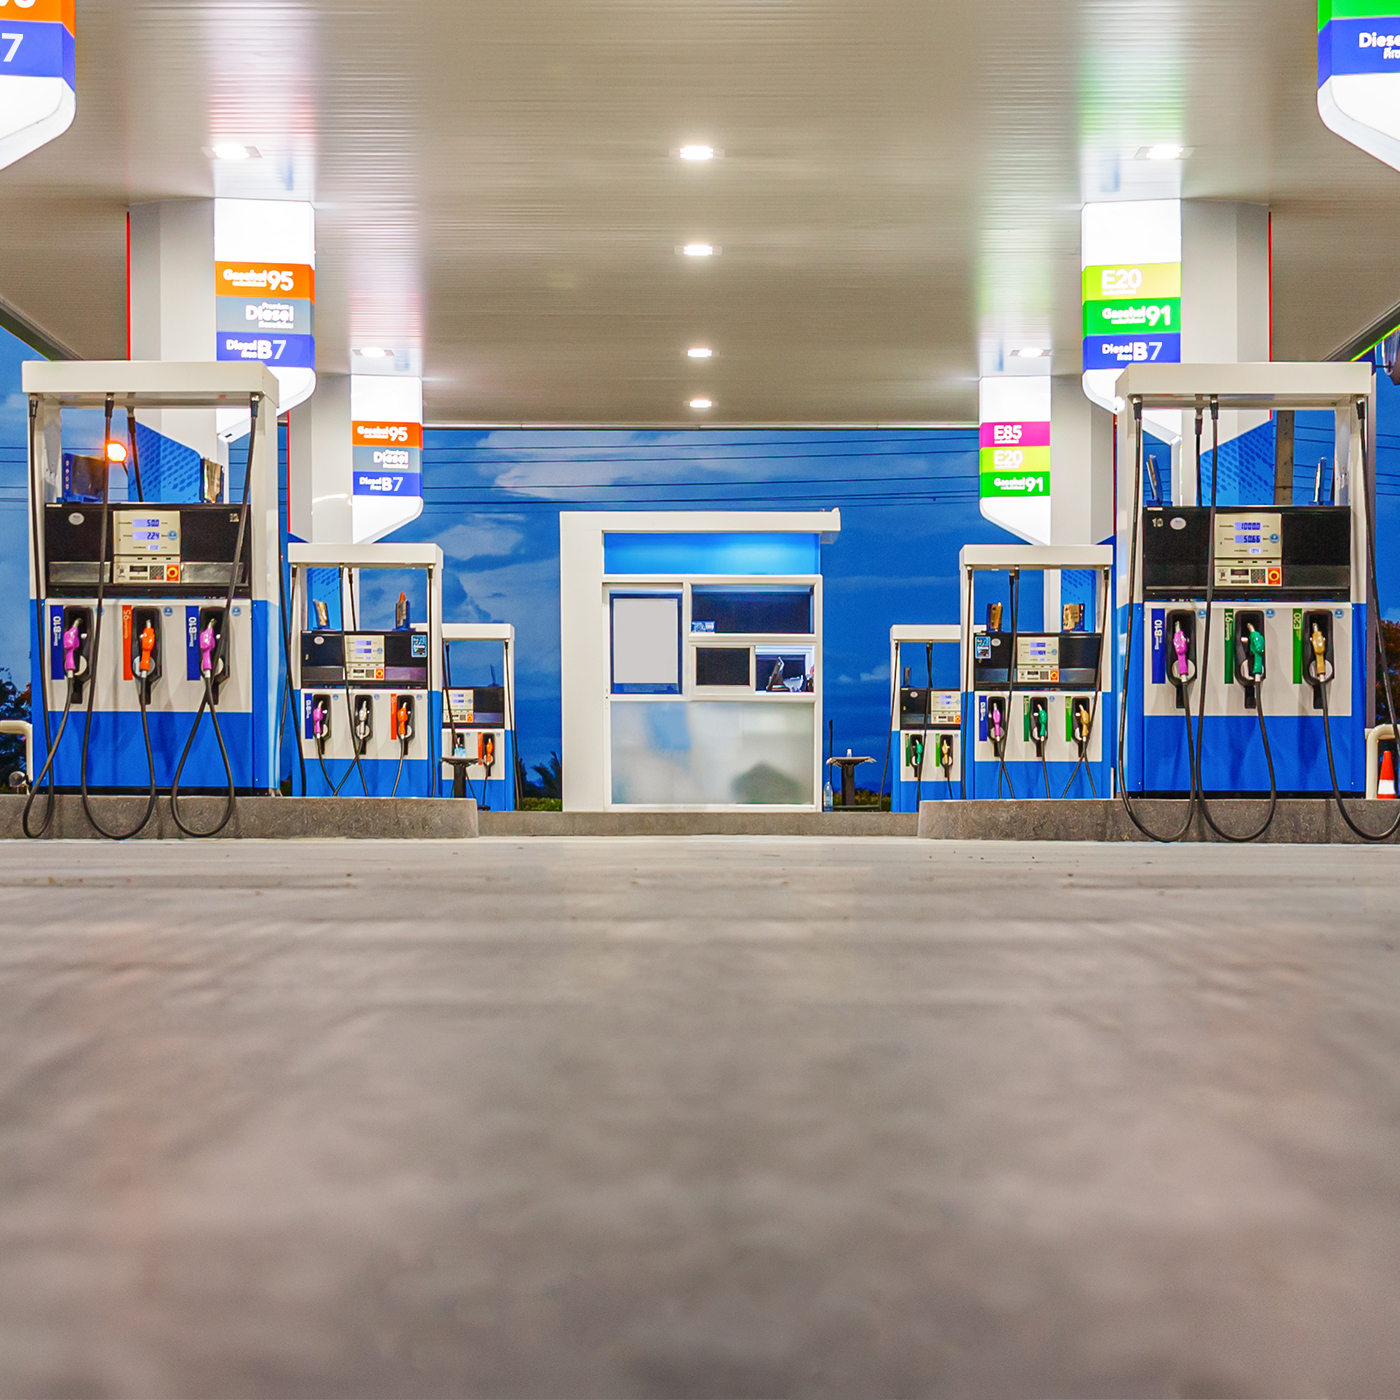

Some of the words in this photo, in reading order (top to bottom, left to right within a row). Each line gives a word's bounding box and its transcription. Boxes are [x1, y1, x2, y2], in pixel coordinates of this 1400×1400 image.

[267, 270, 294, 291] 95
[1101, 267, 1142, 290] E20
[1145, 304, 1171, 327] 91
[257, 339, 287, 360] B7
[1133, 341, 1163, 361] B7
[388, 426, 408, 442] 95
[993, 424, 1022, 440] E85
[993, 449, 1023, 465] E20
[381, 476, 404, 492] B7
[1025, 476, 1044, 492] 91
[53, 615, 62, 633] B10
[188, 616, 197, 634] B10
[1154, 619, 1163, 637] B10
[1293, 612, 1302, 630] E20
